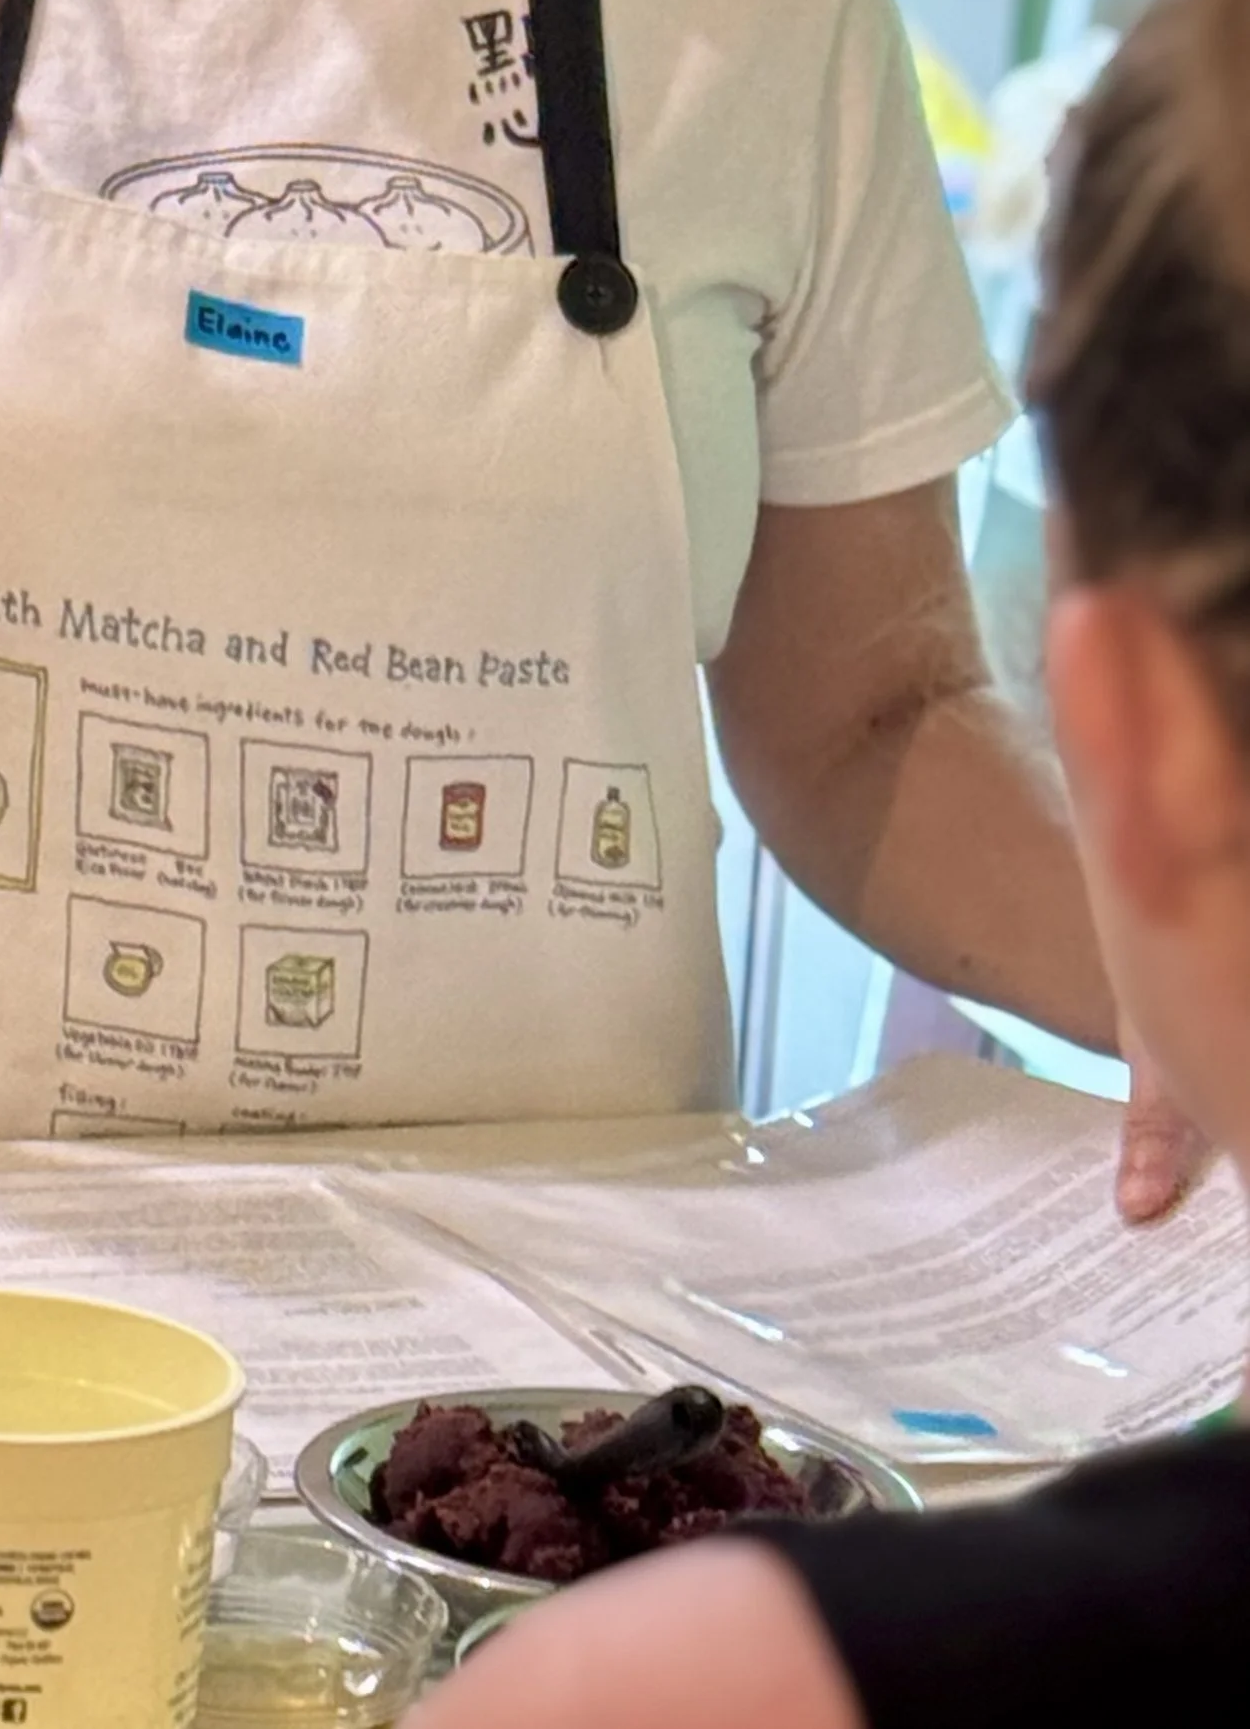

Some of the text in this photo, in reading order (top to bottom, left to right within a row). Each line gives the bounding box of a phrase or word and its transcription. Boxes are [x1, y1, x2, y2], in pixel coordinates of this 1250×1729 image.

[197, 305, 292, 354] Elaine
[59, 598, 206, 655] Matcha
[224, 630, 288, 666] and
[311, 637, 372, 677] Red
[387, 644, 465, 685] Bean
[478, 650, 570, 687] Paste
[196, 691, 304, 724] ingredients
[315, 710, 347, 732] for
